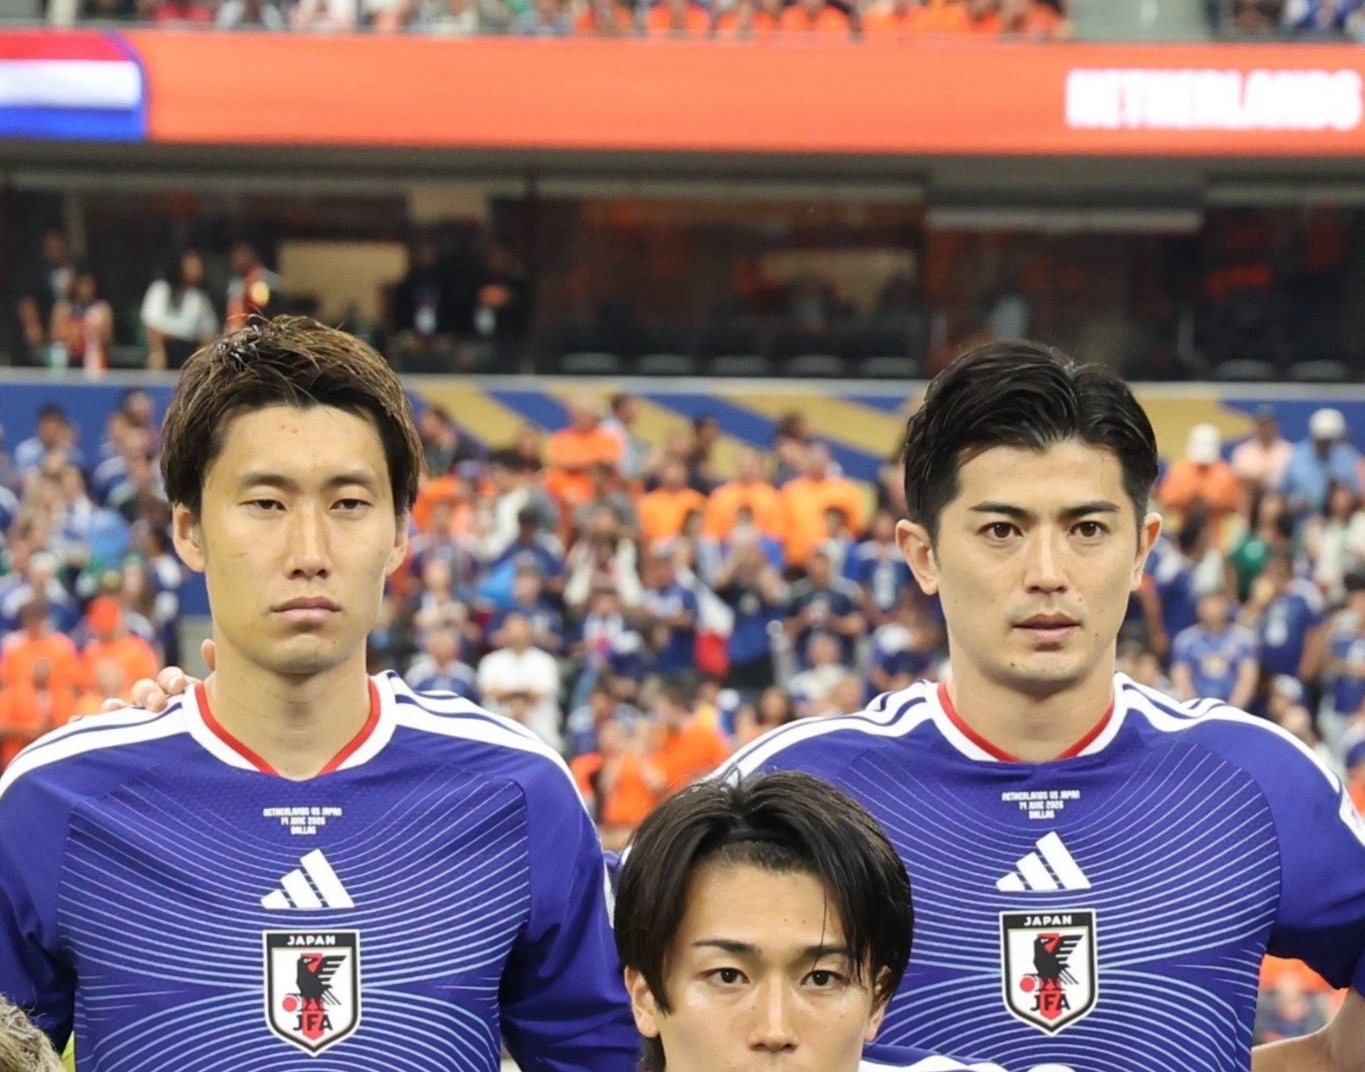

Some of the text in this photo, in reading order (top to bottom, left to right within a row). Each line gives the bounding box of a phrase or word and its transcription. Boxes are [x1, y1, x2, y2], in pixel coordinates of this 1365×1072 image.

[1065, 69, 1363, 130] NETHERLANDS
[1024, 915, 1072, 927] JAPAN
[286, 935, 336, 946] JAPAN
[1030, 993, 1071, 1012] JFA
[292, 1014, 333, 1031] JFA
